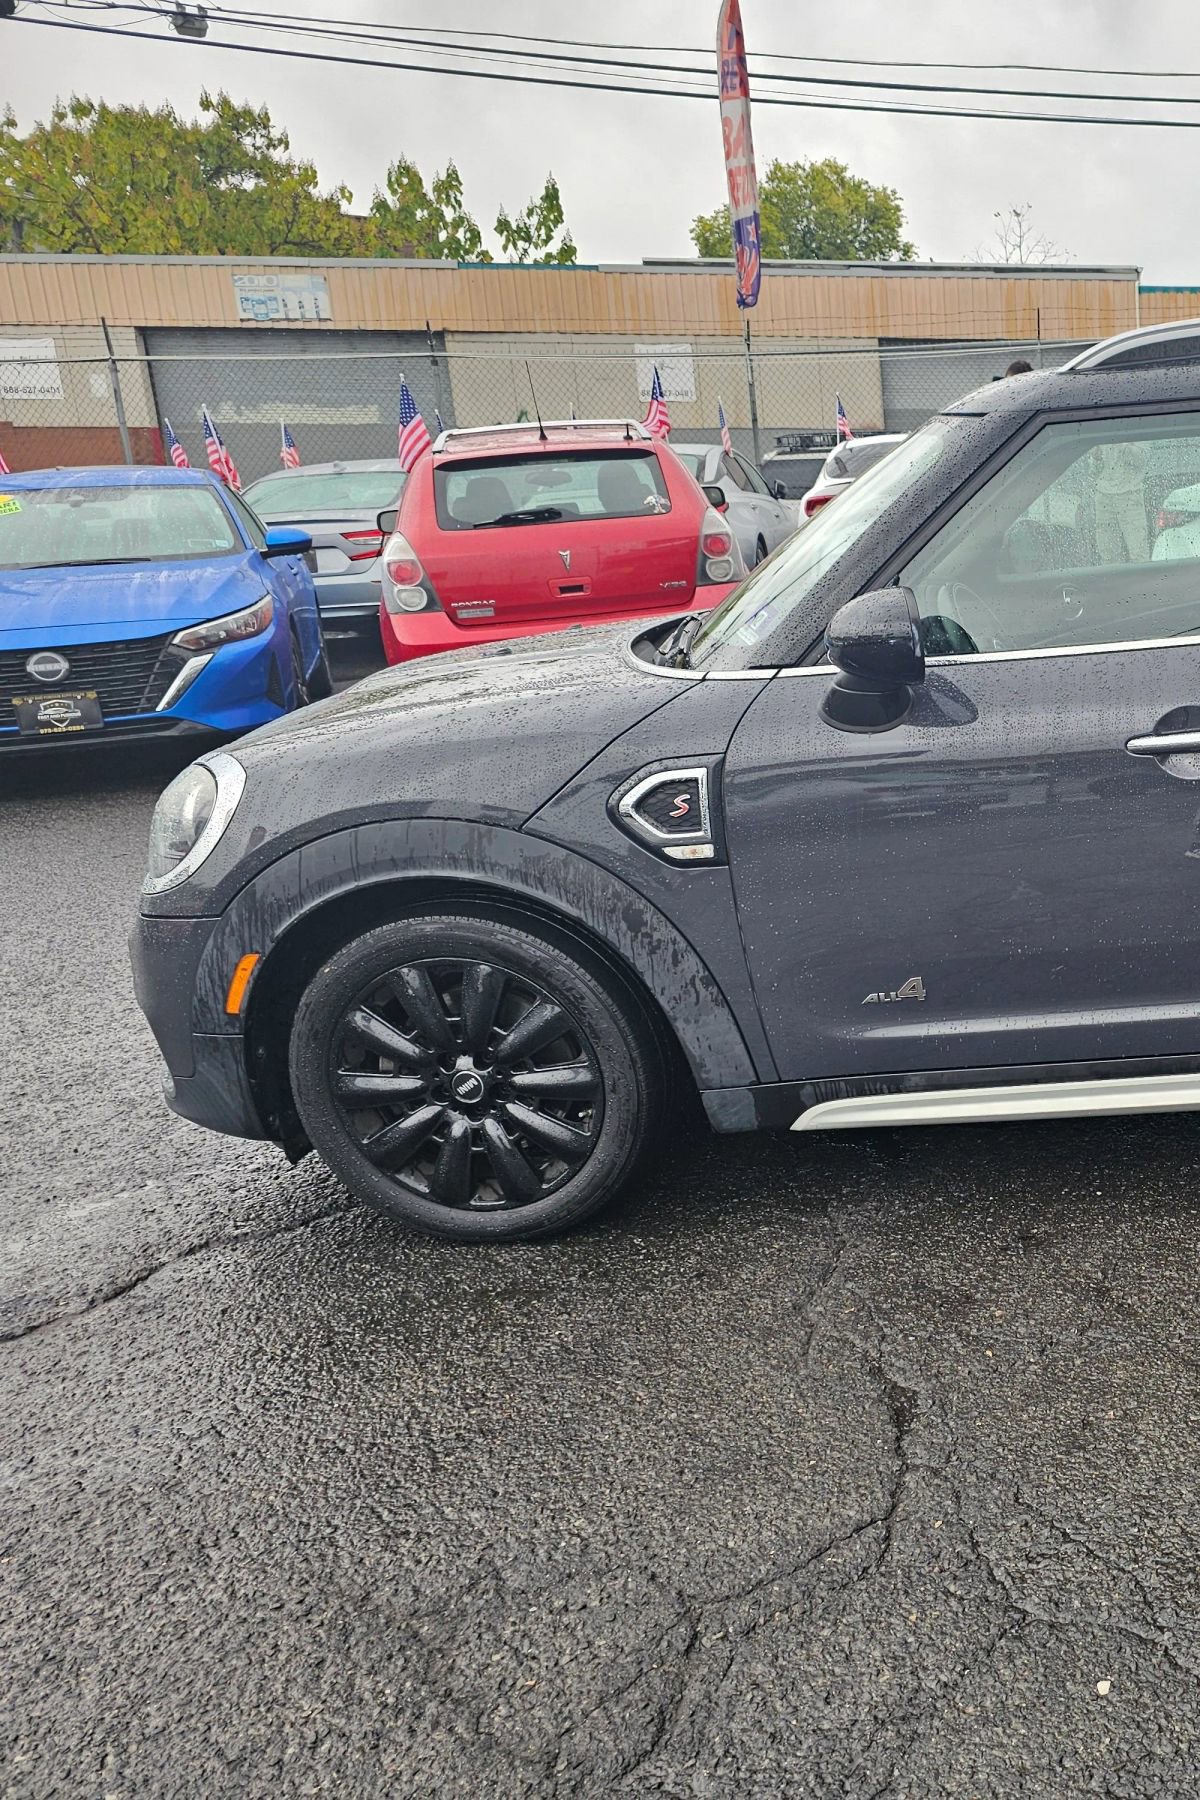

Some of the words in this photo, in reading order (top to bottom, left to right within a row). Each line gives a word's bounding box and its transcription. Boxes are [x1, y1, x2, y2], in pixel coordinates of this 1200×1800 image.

[669, 794, 690, 818] S
[861, 976, 927, 1004] ALL4
[456, 1077, 479, 1096] MINI
